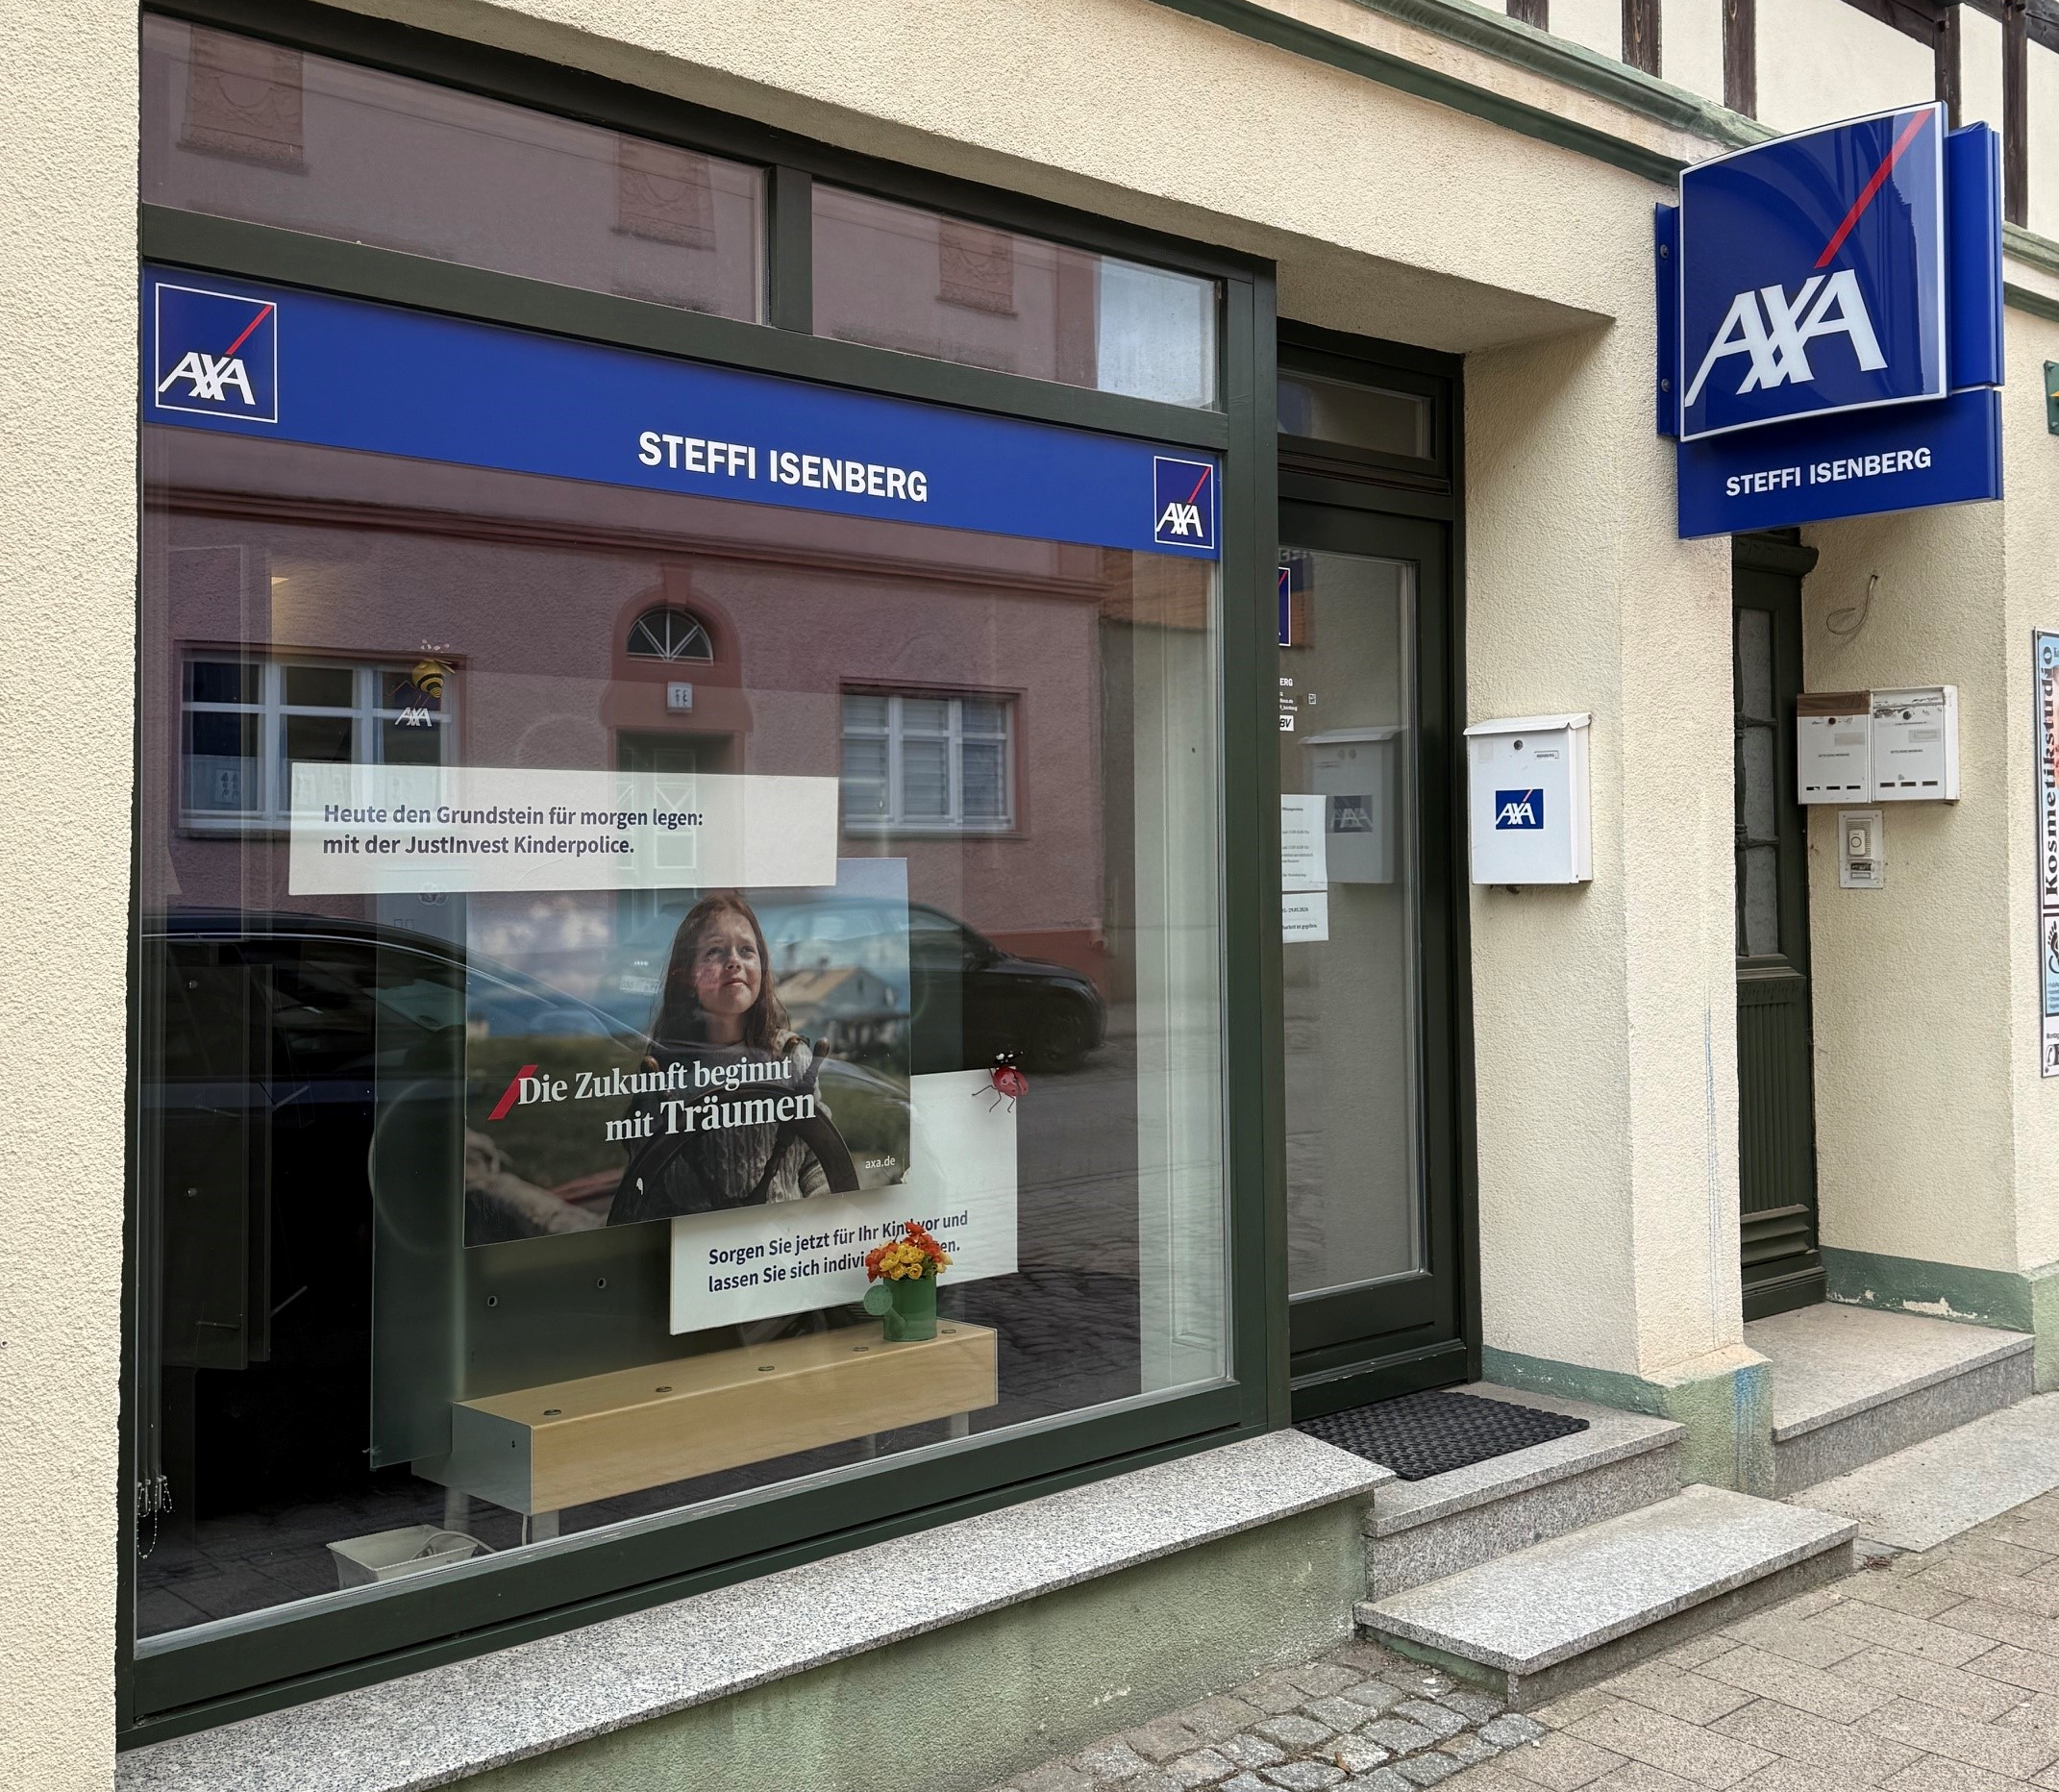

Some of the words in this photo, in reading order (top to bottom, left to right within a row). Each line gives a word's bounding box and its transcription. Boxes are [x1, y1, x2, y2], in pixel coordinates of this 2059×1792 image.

[1684, 269, 1888, 408] AXA
[158, 352, 256, 405] AXA
[637, 431, 757, 480] STEFFI
[769, 449, 928, 502] ISENBERG
[1725, 466, 1801, 496] STEFFI
[1809, 447, 1931, 485] ISENBERG
[1156, 502, 1203, 537] AXA
[395, 707, 433, 727] AXA
[2041, 645, 2058, 896] Kosmetikstudio
[324, 805, 387, 823] Heute
[392, 805, 431, 823] den
[436, 806, 544, 824] Grundstein
[549, 807, 577, 825] für
[580, 811, 648, 830] morgen
[653, 809, 703, 830] legen:
[1496, 803, 1536, 825] AXA
[323, 834, 360, 854] mit
[364, 834, 401, 854] der
[405, 835, 509, 854] JustInvest
[514, 835, 634, 857] Kinderpolice.
[517, 1074, 568, 1106] Die
[575, 1061, 688, 1100] Zukunft
[692, 1056, 792, 1091] beginnt
[605, 1110, 655, 1142] mit
[659, 1093, 816, 1134] Träumen
[865, 1156, 896, 1169] axa.de
[708, 1245, 764, 1265] Sorgen
[769, 1237, 792, 1256] Sie
[794, 1232, 830, 1256] jetzt
[832, 1228, 856, 1246] für
[858, 1225, 879, 1242] Ihr
[943, 1210, 968, 1229] und
[708, 1273, 758, 1292] lassen
[763, 1265, 786, 1283] Sie
[790, 1260, 819, 1279] sich
